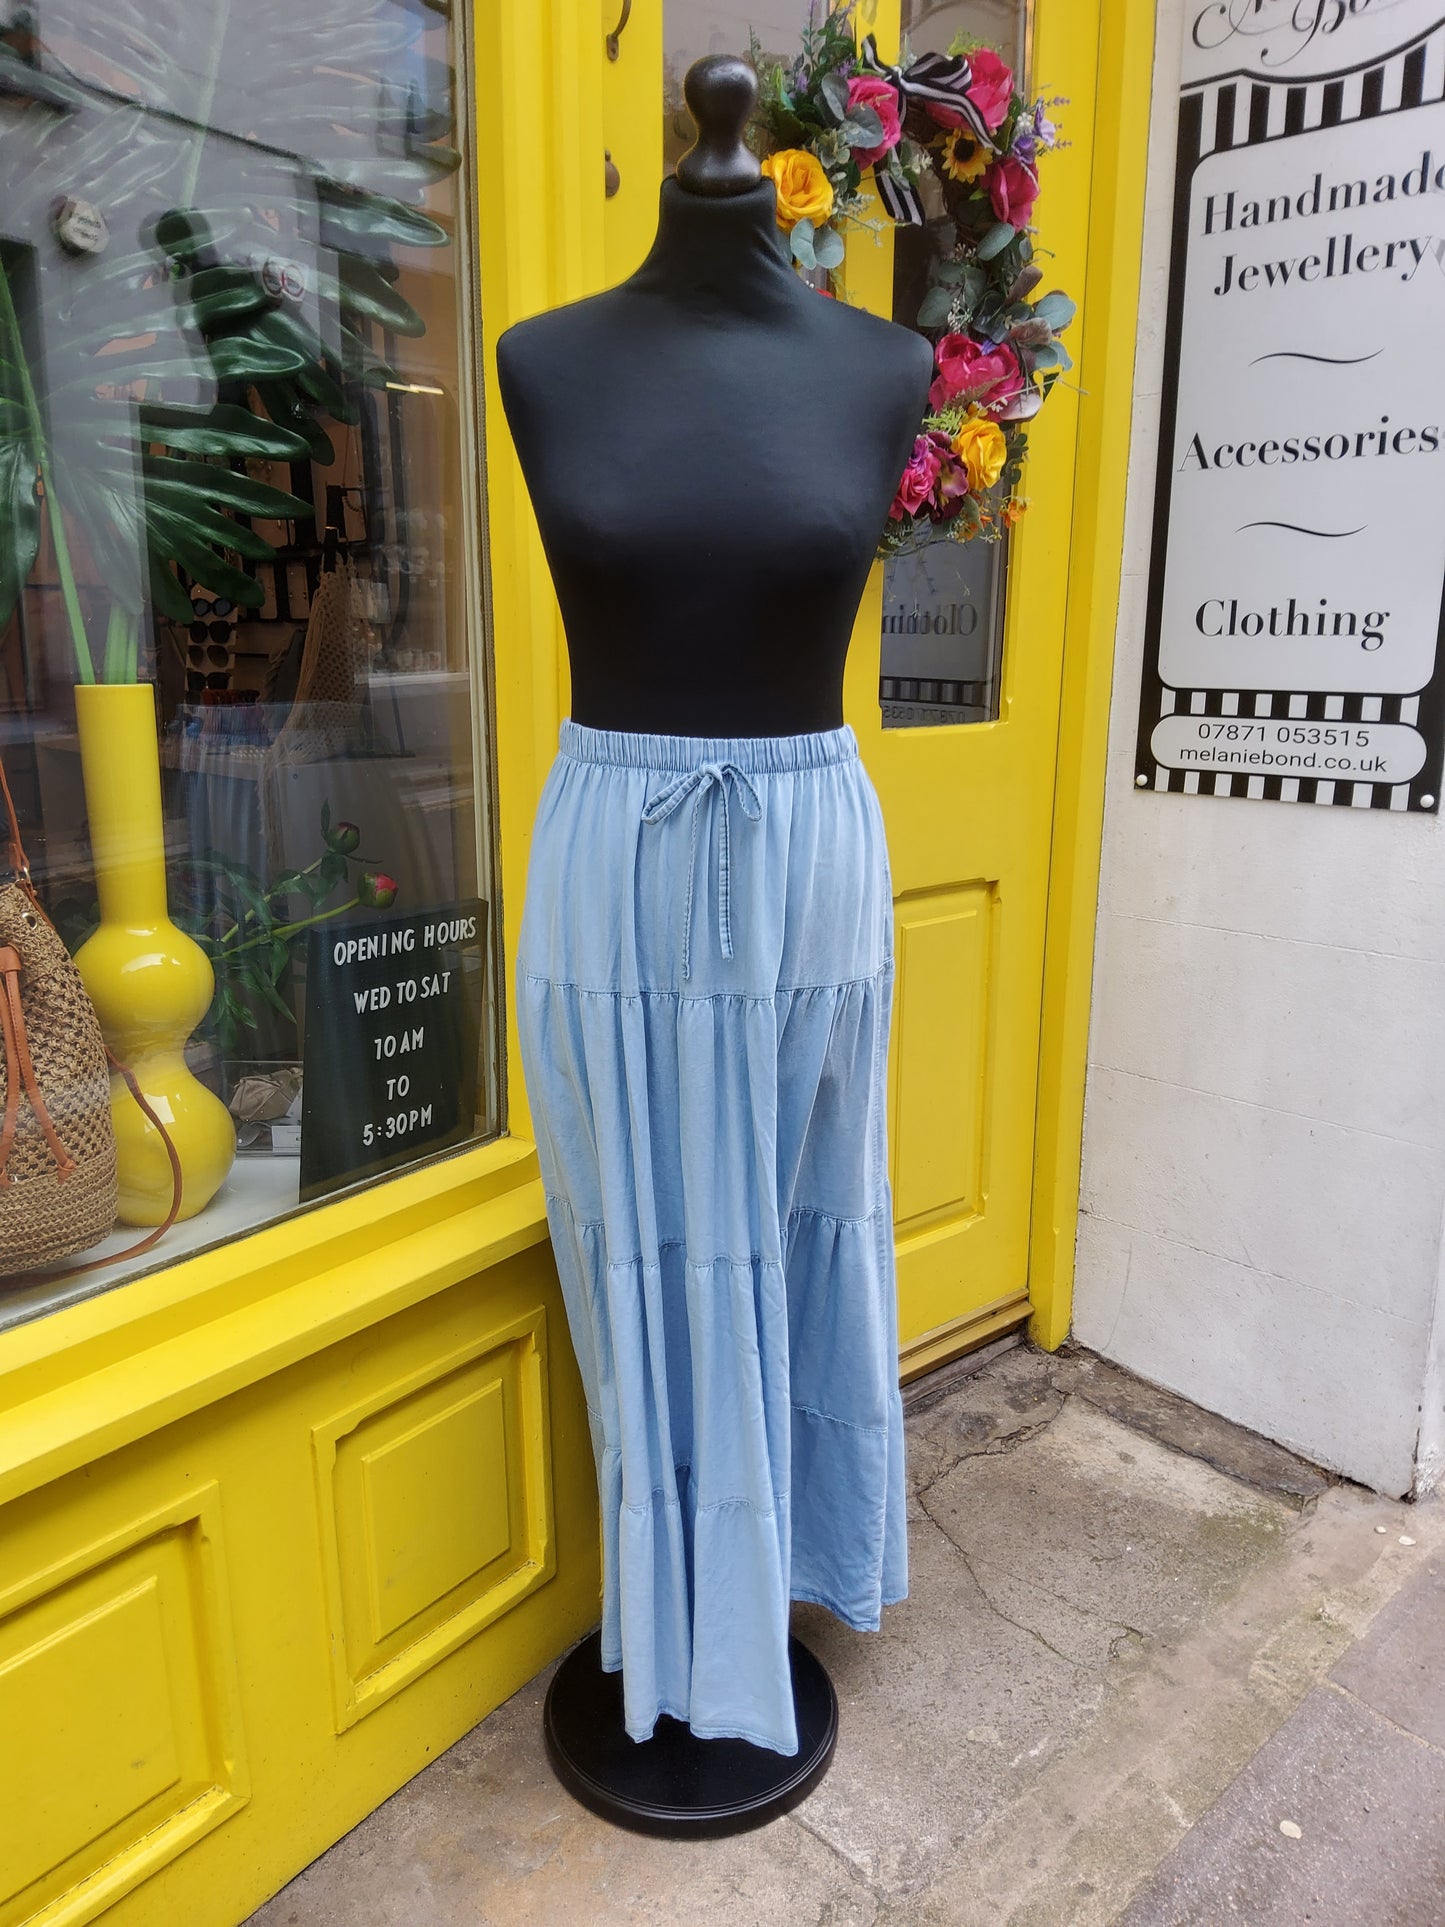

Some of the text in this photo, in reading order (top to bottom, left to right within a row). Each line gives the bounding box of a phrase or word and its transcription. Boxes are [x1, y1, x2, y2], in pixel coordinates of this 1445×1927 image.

[1213, 233, 1433, 296] Jewellery
[1177, 415, 1440, 472] Accessories
[1195, 598, 1391, 652] Clothing
[1198, 723, 1370, 748] 07871 053515
[1179, 747, 1387, 773] melaniebond.co.uk
[333, 916, 477, 966] OPENING HOURS
[353, 971, 451, 1014] WED TO SAT
[386, 1075, 410, 1101] TO
[362, 1103, 433, 1146] 5:30PM
